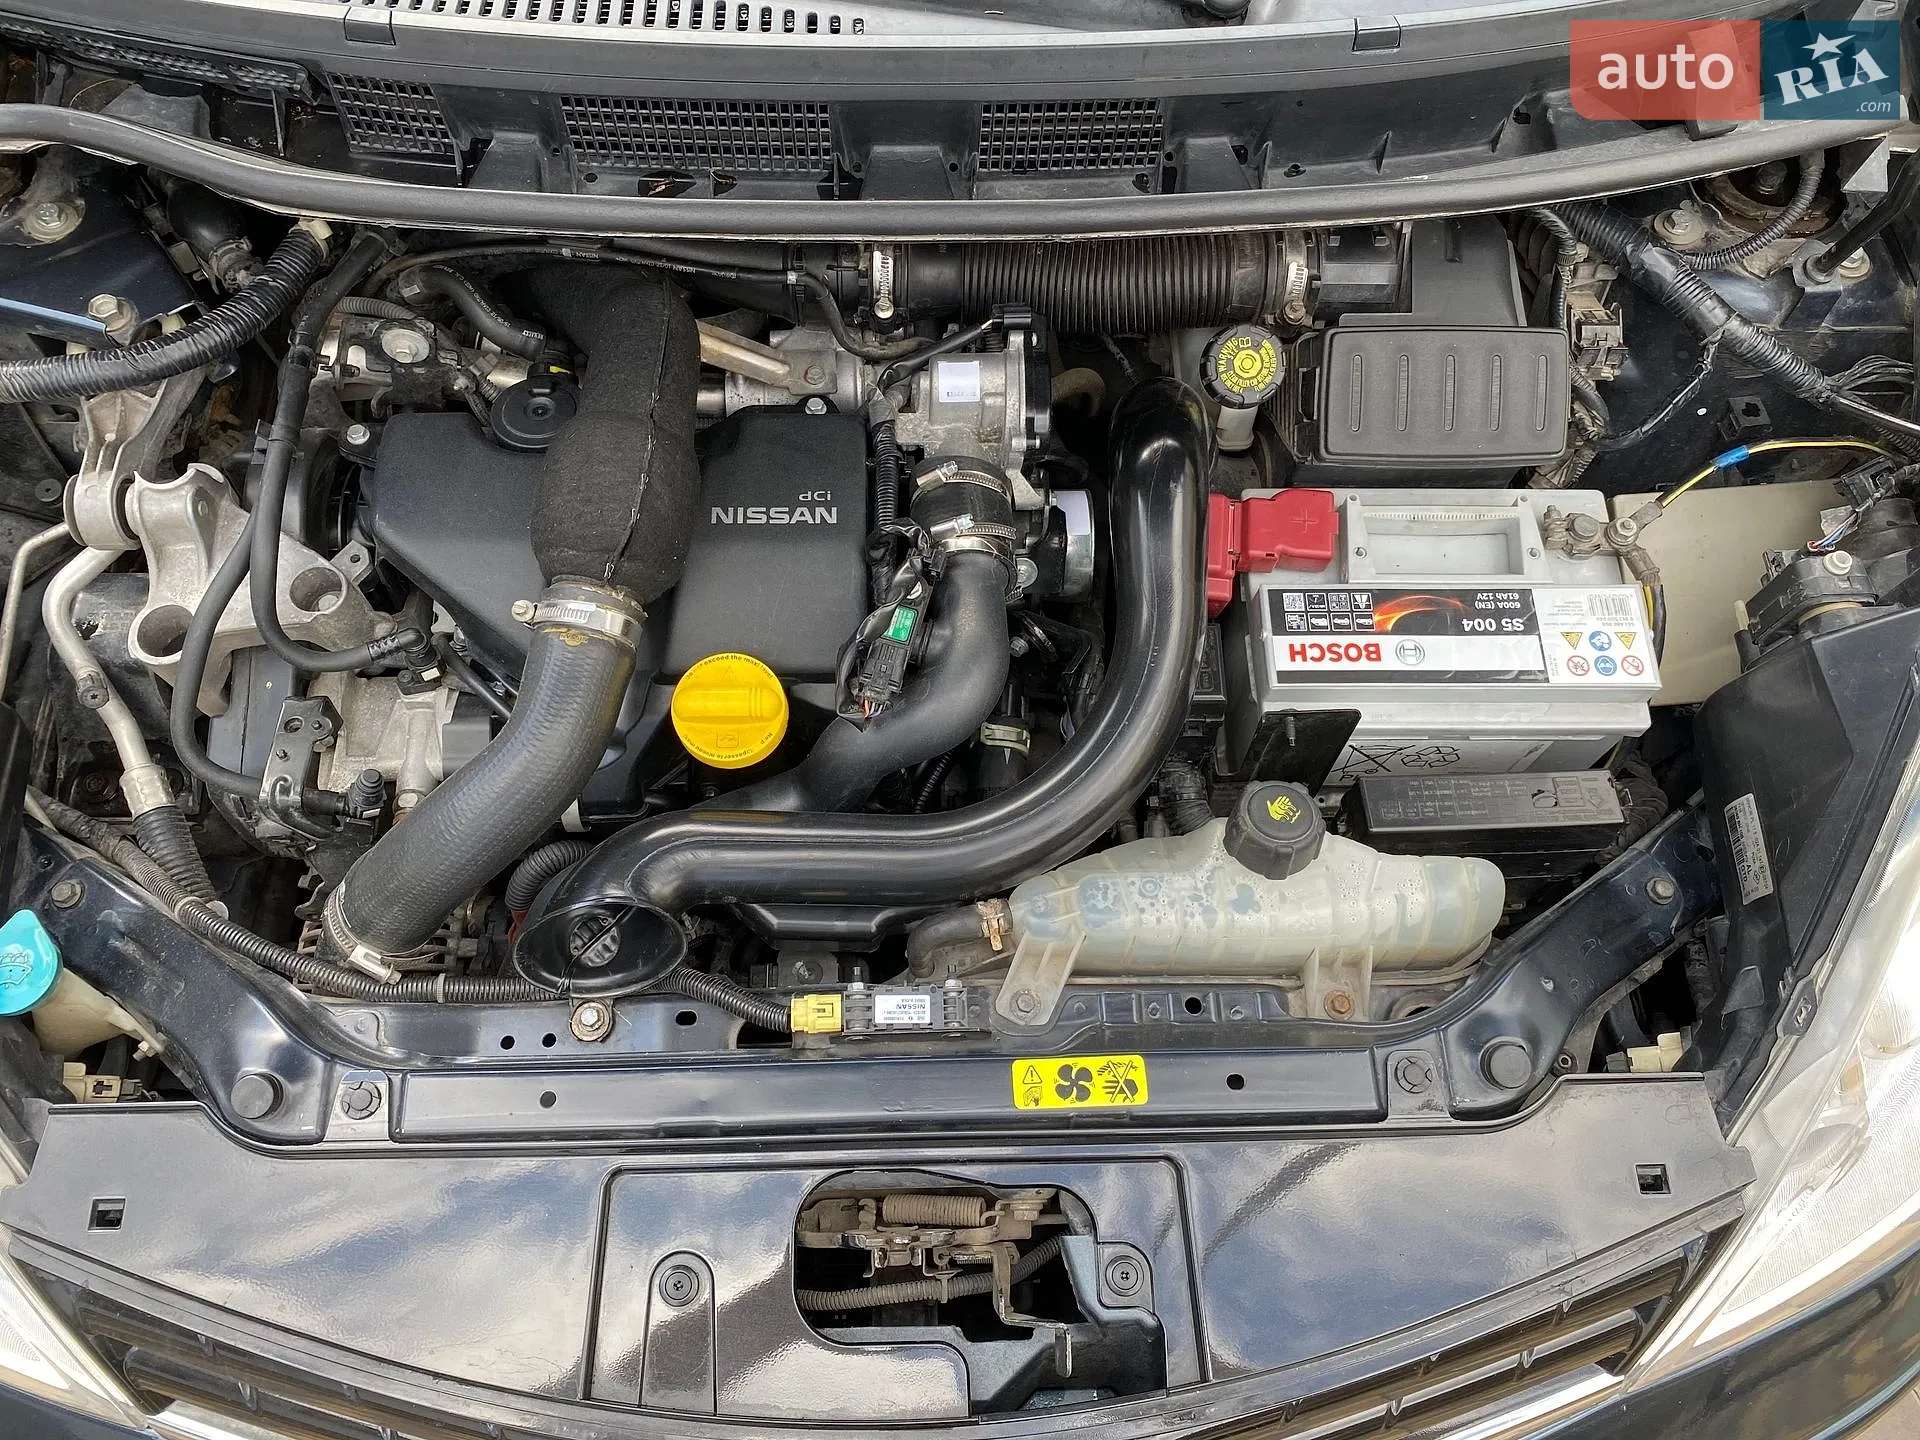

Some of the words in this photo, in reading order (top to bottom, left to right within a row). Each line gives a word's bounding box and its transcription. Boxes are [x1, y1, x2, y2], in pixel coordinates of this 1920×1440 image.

[1218, 337, 1238, 372] WARNING
[1228, 346, 1239, 360] SEE
[798, 489, 831, 501] dCi
[710, 506, 838, 525] NISSAN
[1476, 592, 1493, 600] 12V
[1475, 601, 1495, 610] (EN)
[1496, 601, 1521, 609] 600A
[1462, 618, 1495, 632] 004
[1502, 617, 1525, 632] S5
[1289, 643, 1382, 663] BOSCH
